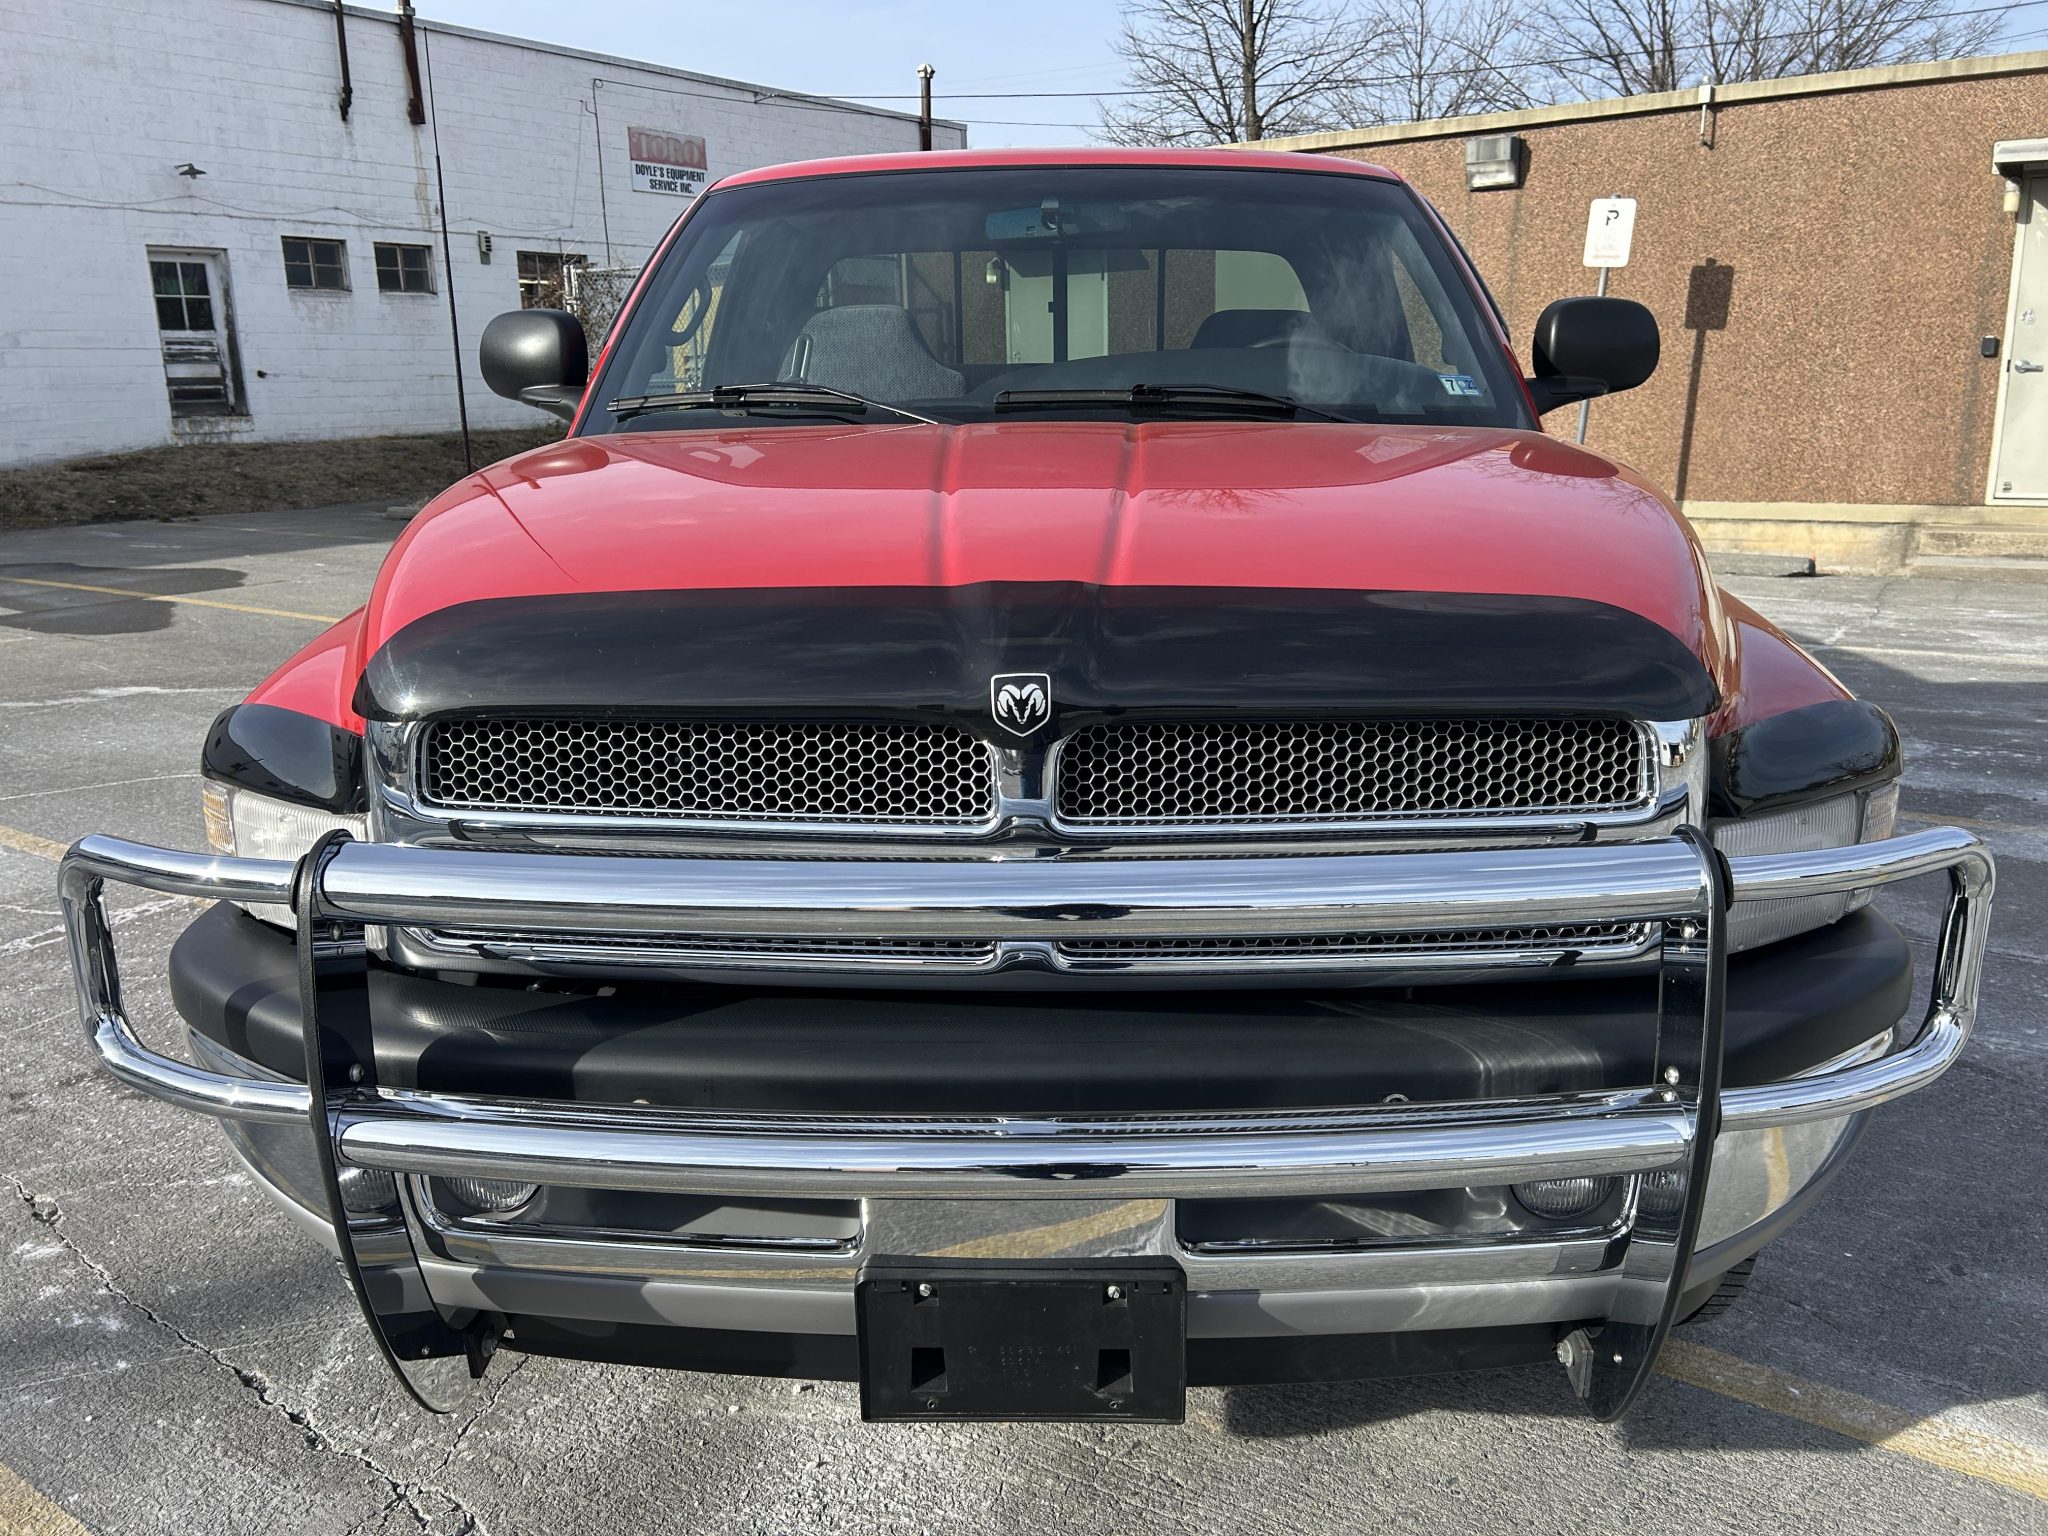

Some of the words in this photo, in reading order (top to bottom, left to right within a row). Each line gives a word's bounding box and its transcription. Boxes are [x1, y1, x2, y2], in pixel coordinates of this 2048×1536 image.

[631, 133, 700, 163] TORO
[635, 163, 665, 178] DOYLE'S
[666, 169, 705, 183] EQUIPMENT
[649, 178, 678, 192] SERVICE
[680, 183, 694, 194] INC.
[1445, 379, 1456, 392] 7
